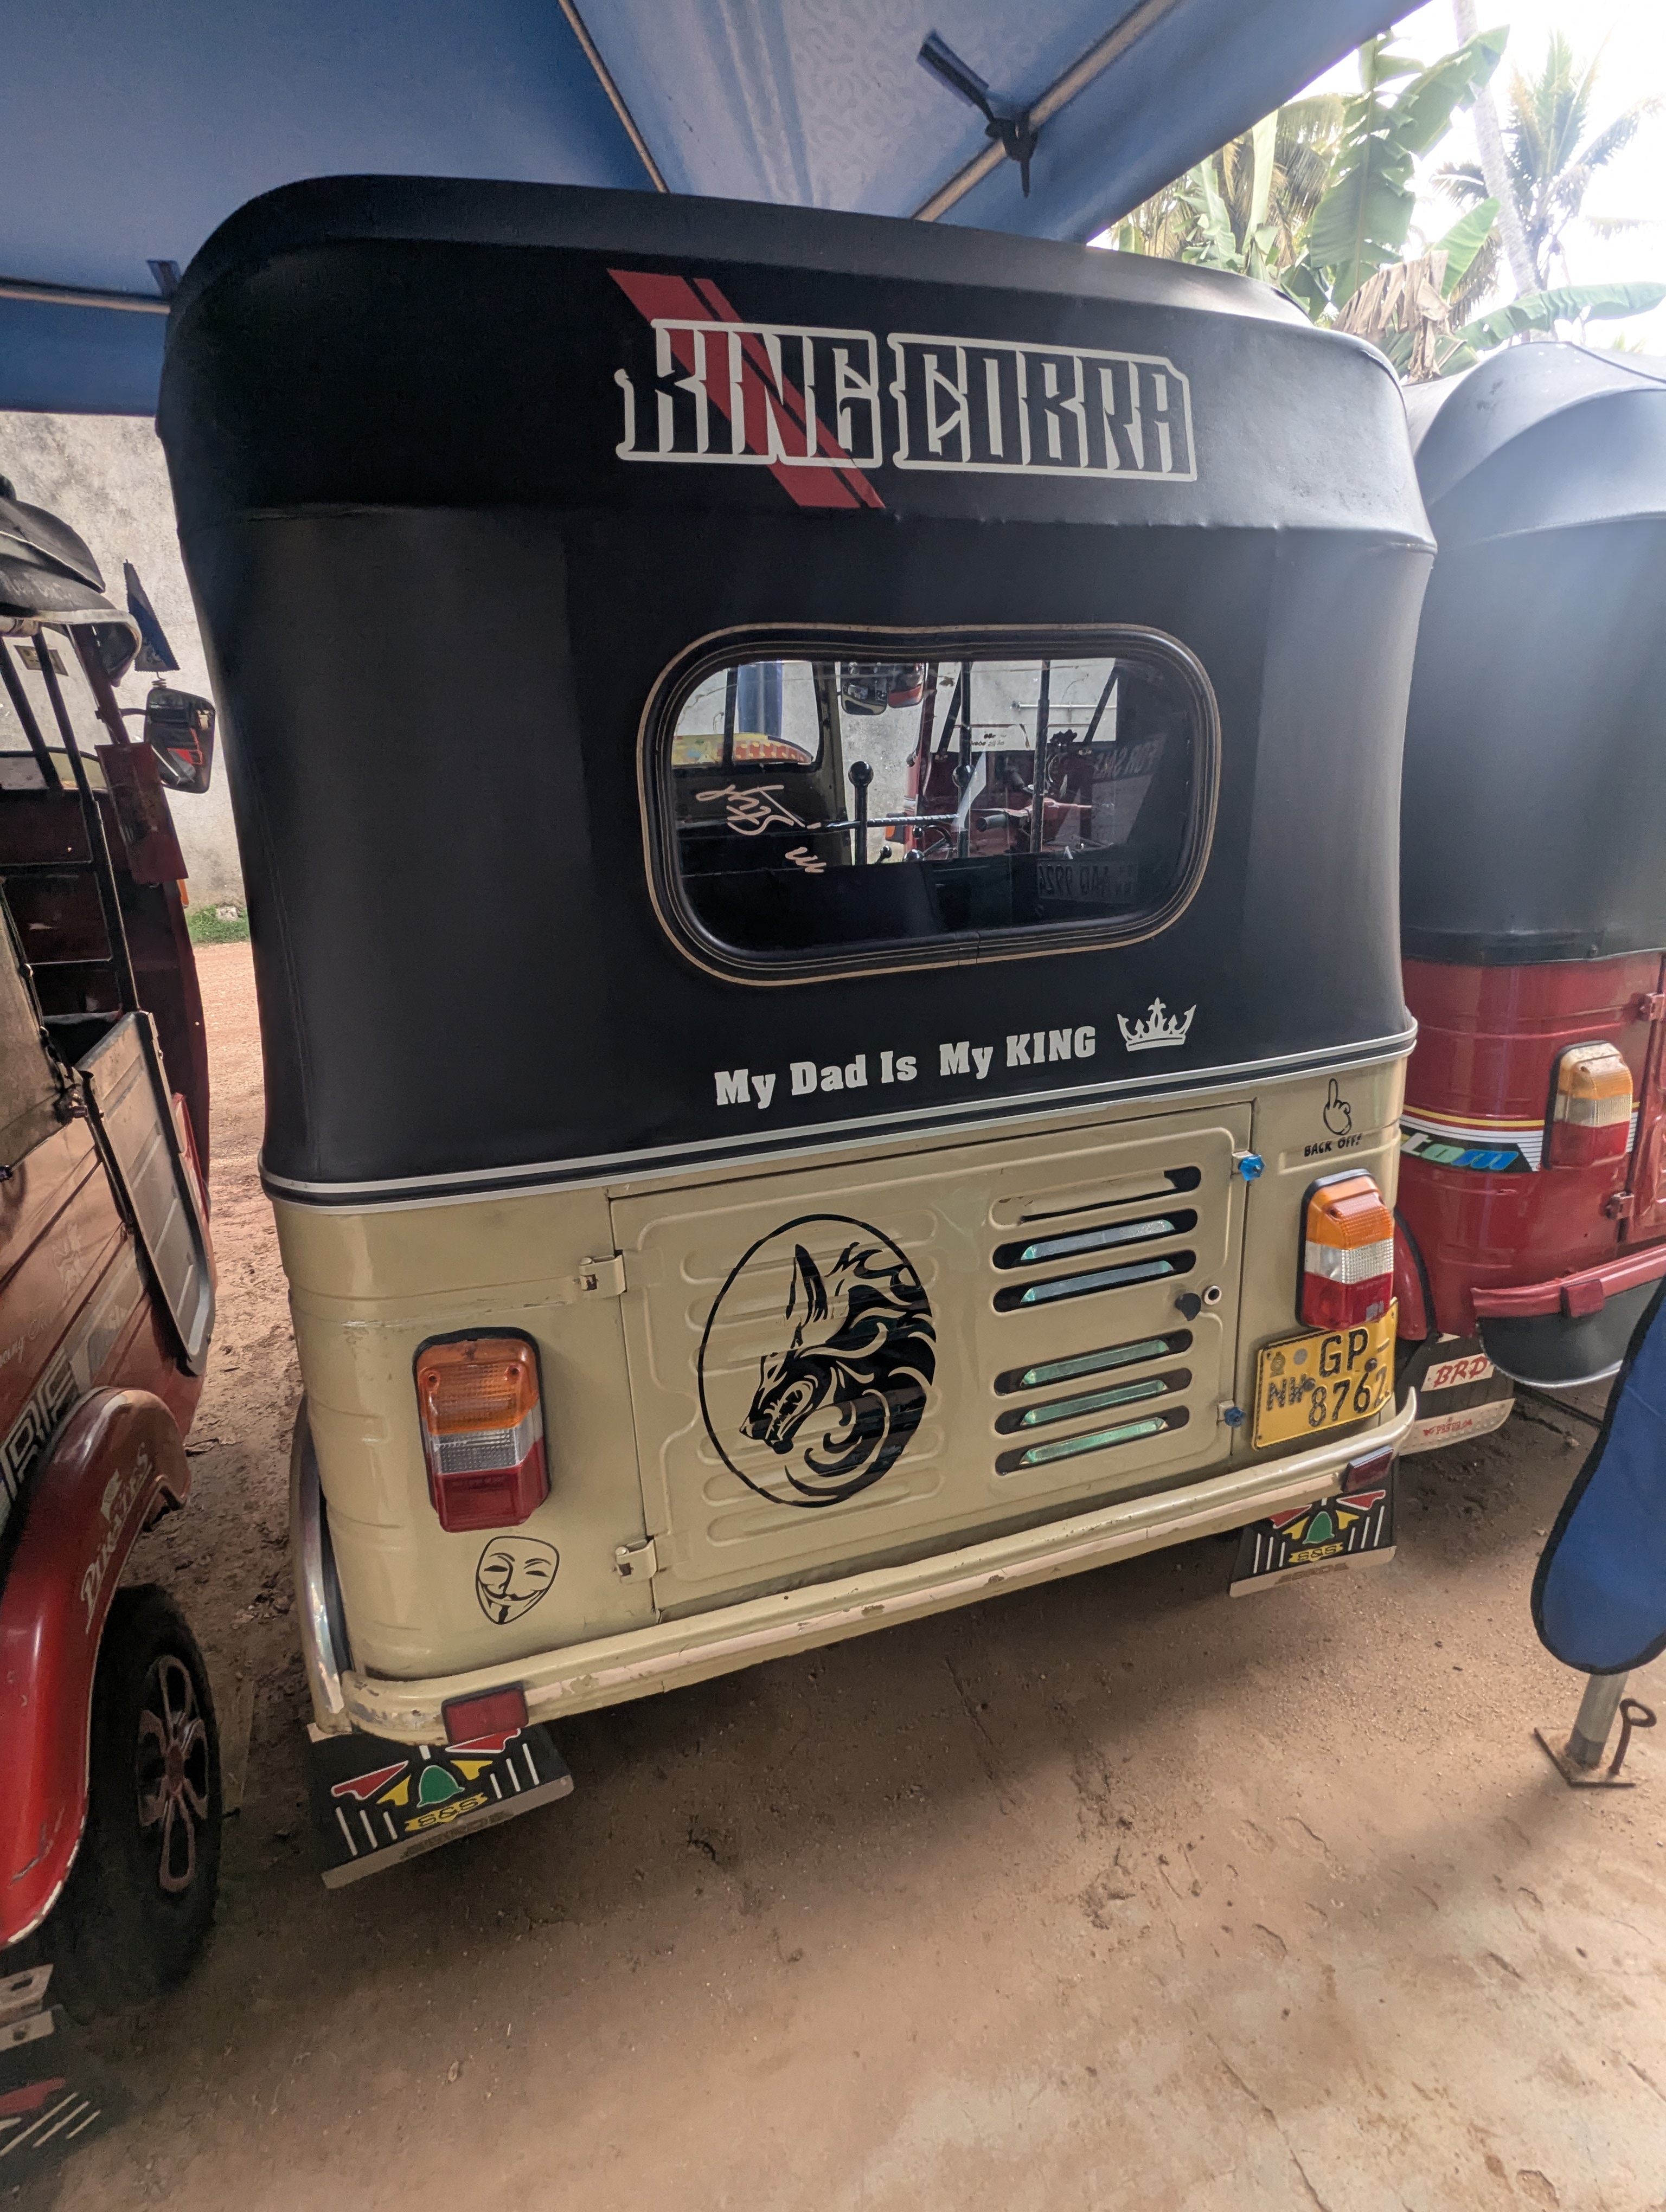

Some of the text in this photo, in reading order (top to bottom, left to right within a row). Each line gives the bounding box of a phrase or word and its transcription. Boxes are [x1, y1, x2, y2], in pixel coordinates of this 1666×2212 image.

[714, 1026, 1095, 1109] My Dad Is My KING
[1304, 1133, 1362, 1157] BACK OFF!
[1433, 1356, 1489, 1388] BRD
[1308, 1365, 1387, 1427] 8762
